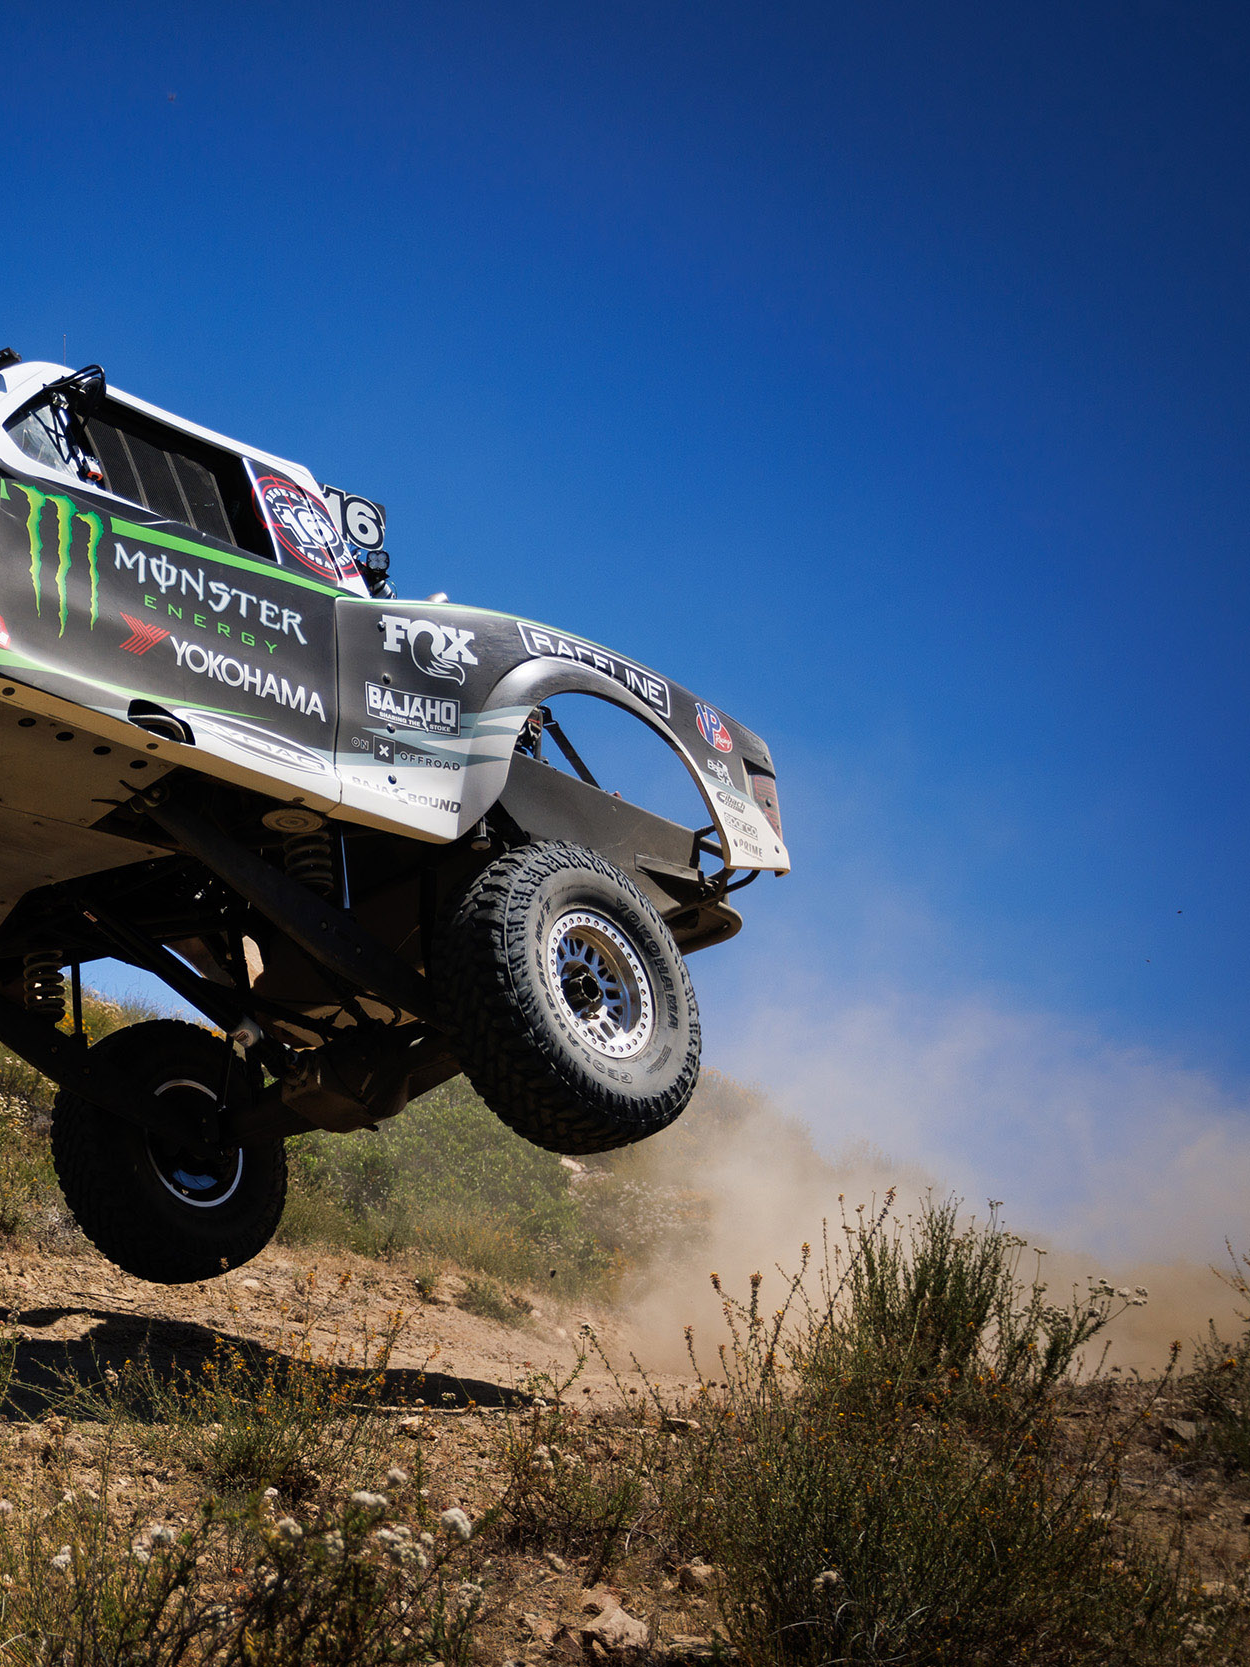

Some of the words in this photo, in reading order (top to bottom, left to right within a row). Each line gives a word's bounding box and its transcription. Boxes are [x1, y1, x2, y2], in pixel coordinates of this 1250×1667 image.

[323, 485, 384, 550] 16
[144, 594, 278, 655] ENERGY
[382, 613, 479, 667] FOX
[170, 635, 326, 723] YOKOHAMA
[379, 711, 408, 724] SHARING
[408, 719, 421, 727] THE
[429, 723, 451, 732] STOKE
[694, 702, 722, 746] VP
[351, 736, 370, 751] ON
[399, 750, 461, 772] OFFROAD
[407, 792, 462, 814] BOUND
[615, 897, 680, 1030] YOKOHAMA
